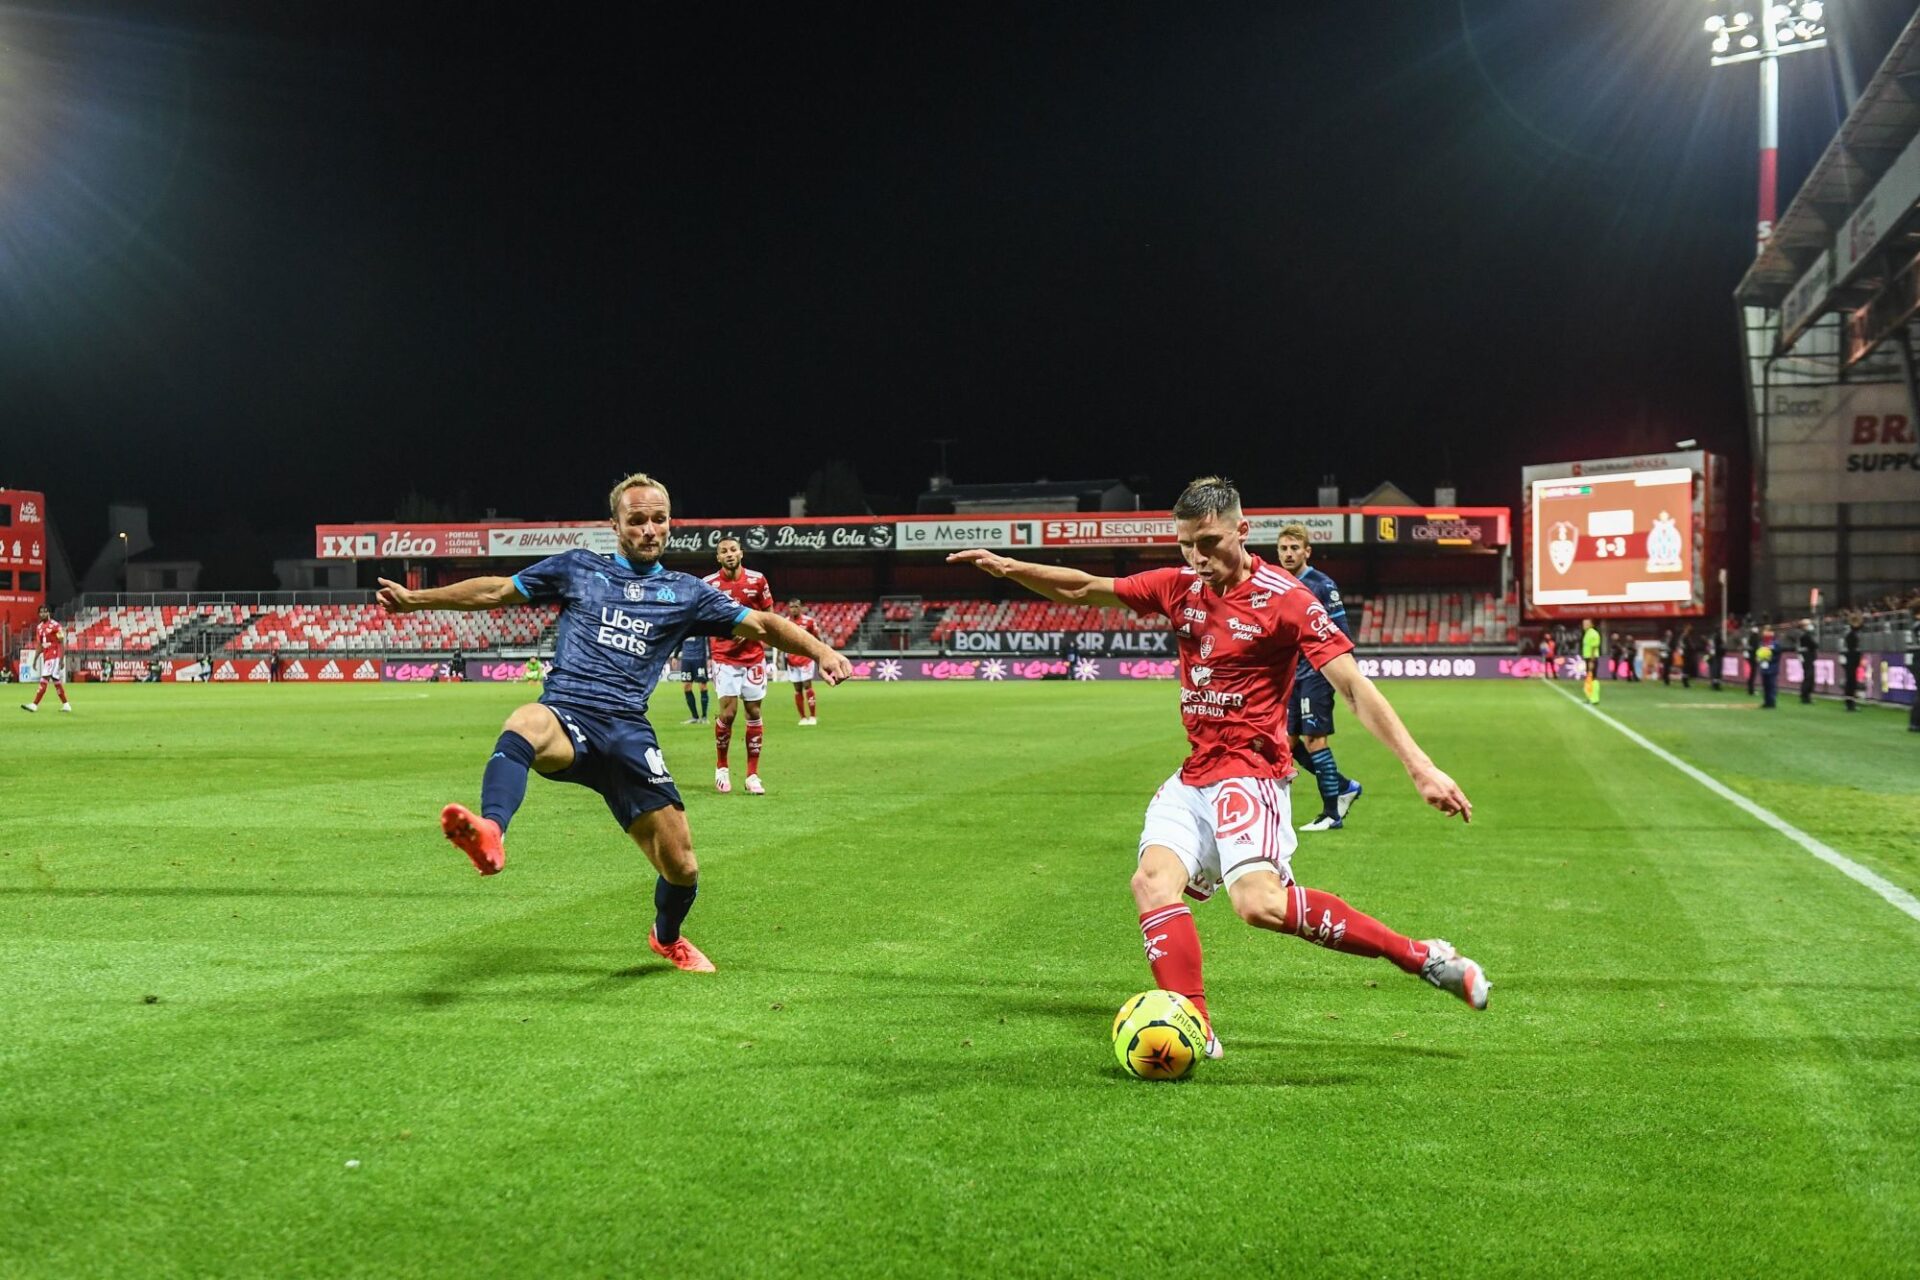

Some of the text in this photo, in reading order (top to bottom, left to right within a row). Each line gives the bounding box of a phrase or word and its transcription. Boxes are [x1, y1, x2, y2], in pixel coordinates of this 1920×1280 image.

[519, 533, 583, 546] BIHANNIC
[775, 526, 866, 549] Breizh Cola
[905, 524, 1003, 541] Le Mestre
[382, 531, 436, 556] déco
[666, 532, 702, 551] reizh
[601, 606, 653, 636] Uber
[1229, 617, 1262, 634] Oceania
[597, 625, 647, 656] Eats
[955, 631, 1168, 650] BON VENT SIR ALEX
[114, 661, 146, 670] DIGITAL
[1358, 659, 1379, 677] 02
[1381, 659, 1403, 677] 98
[1429, 659, 1451, 677] 60
[1453, 659, 1476, 677] 00
[214, 672, 239, 680] adidas
[283, 672, 309, 680] adidas
[318, 672, 344, 680] adidas
[353, 672, 379, 680] adidas
